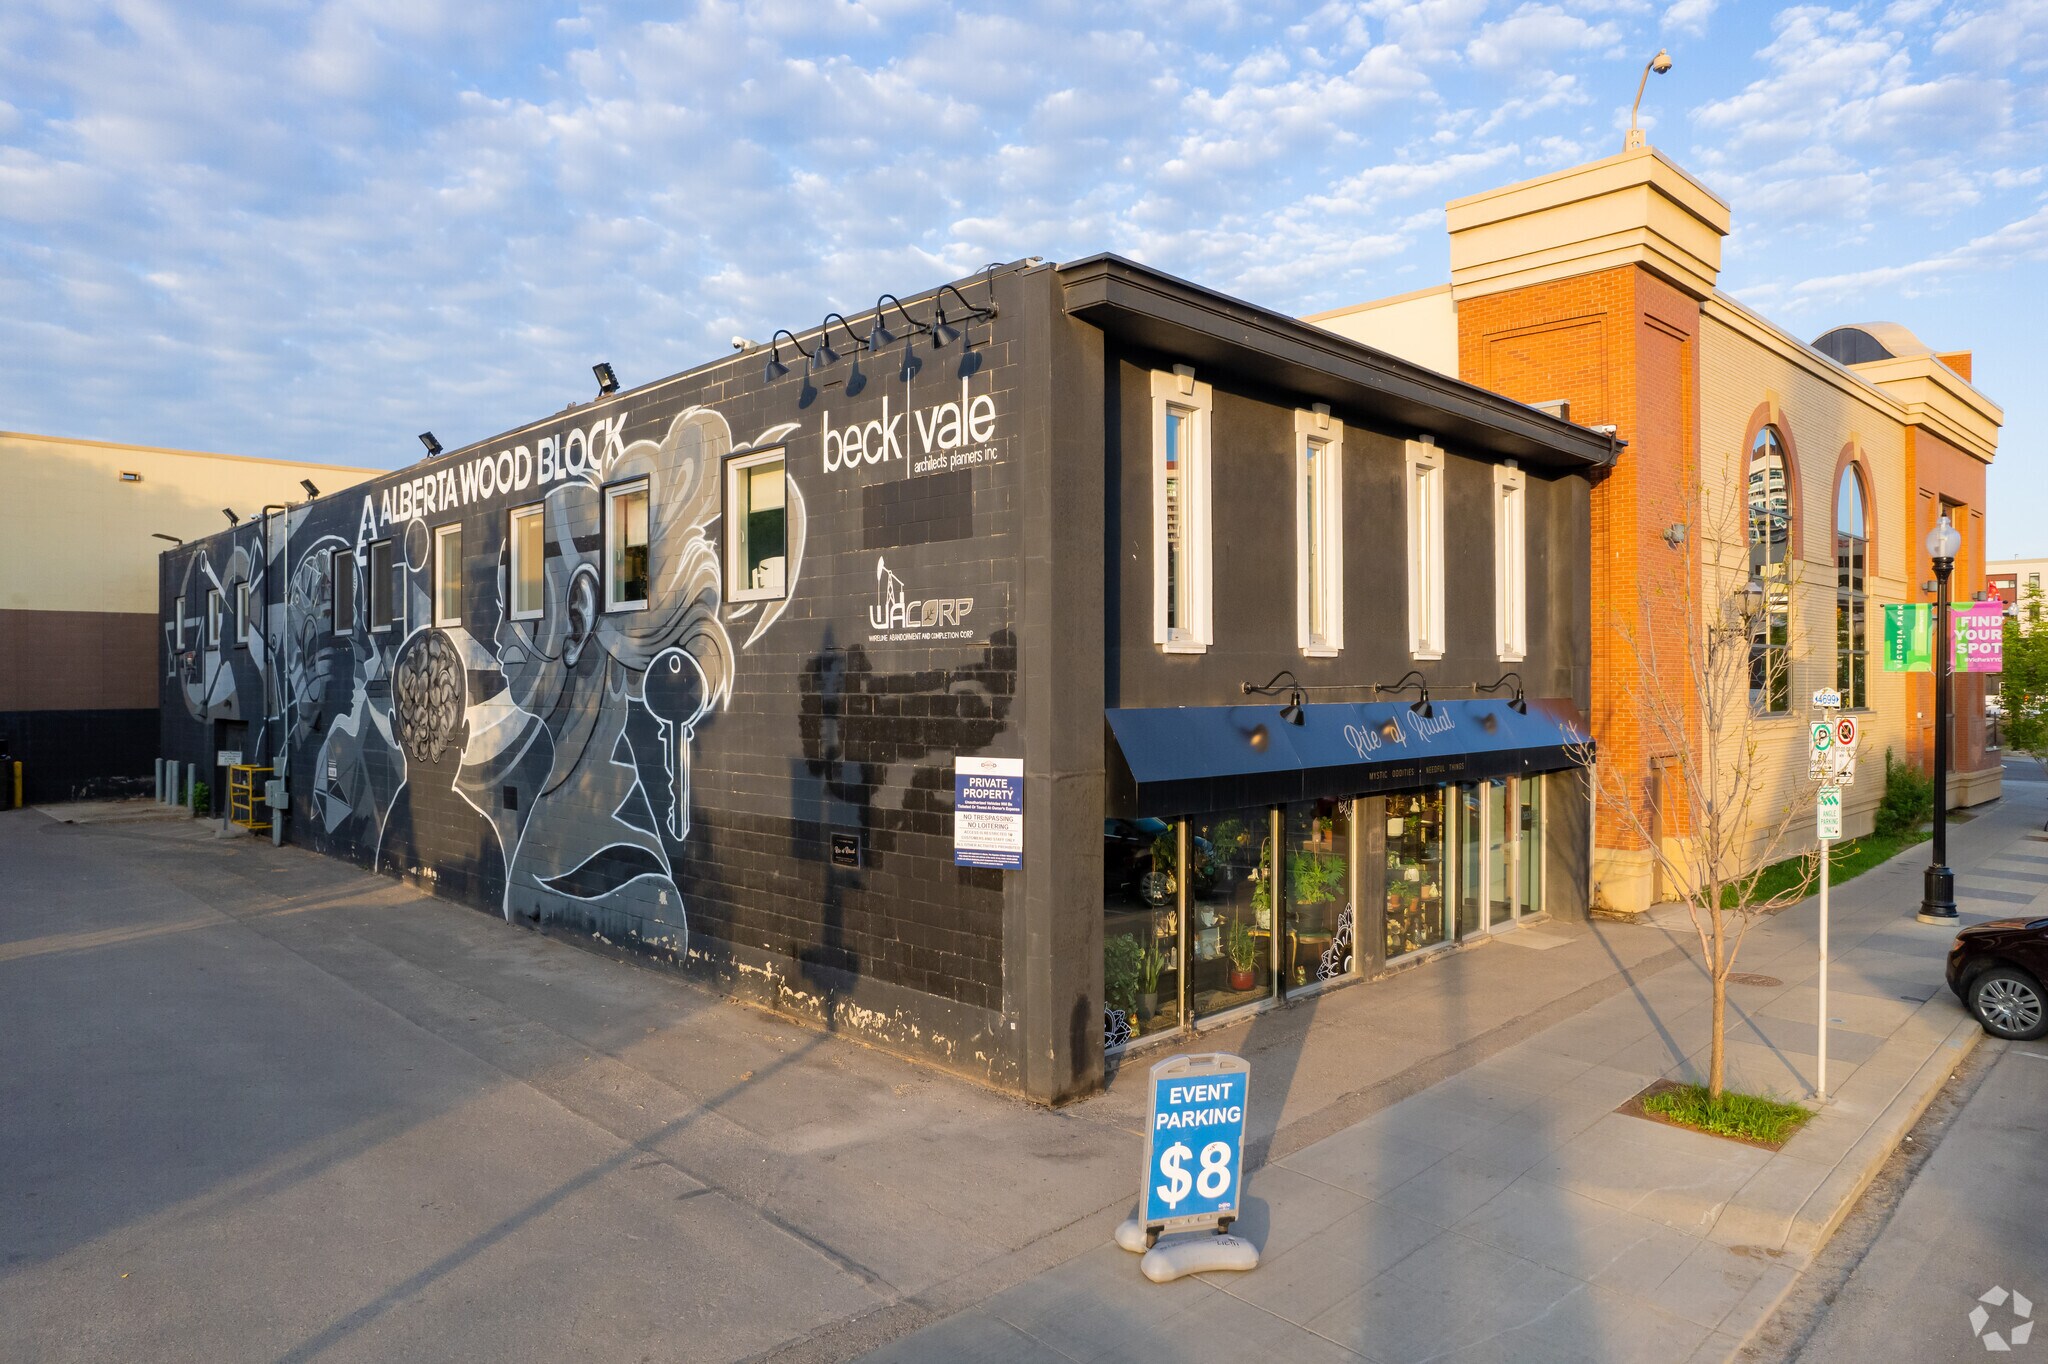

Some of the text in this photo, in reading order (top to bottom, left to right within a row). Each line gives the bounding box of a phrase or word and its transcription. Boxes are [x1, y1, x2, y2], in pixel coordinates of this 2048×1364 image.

[823, 376, 996, 473] beck vale
[914, 444, 998, 473] architects planners inc
[380, 467, 459, 527] ALBERTA
[459, 445, 532, 505] WOOD
[537, 412, 629, 486] BLOCK
[1896, 604, 1904, 626] PARK
[1961, 615, 2003, 627] FIND
[868, 634, 888, 642] WIRELINE
[889, 632, 922, 641] ABANDONMENT
[931, 631, 960, 640] COMPLETION
[960, 630, 974, 638] CORP
[1954, 629, 2002, 640] YOUR
[1956, 642, 2002, 654] SPOT
[1344, 706, 1456, 760] Rite of Ritual
[1368, 762, 1465, 780] MYSTIC ODDITIES NEEDFUL THINGS
[969, 777, 1008, 789] PRIVATE
[963, 788, 1014, 800] PROPERTY
[973, 814, 1014, 822] TRESPASSING
[977, 822, 1009, 830] LOITERING
[1169, 1083, 1233, 1104] EVENT
[1156, 1106, 1241, 1130] PARKING
[1156, 1141, 1232, 1210] $8
